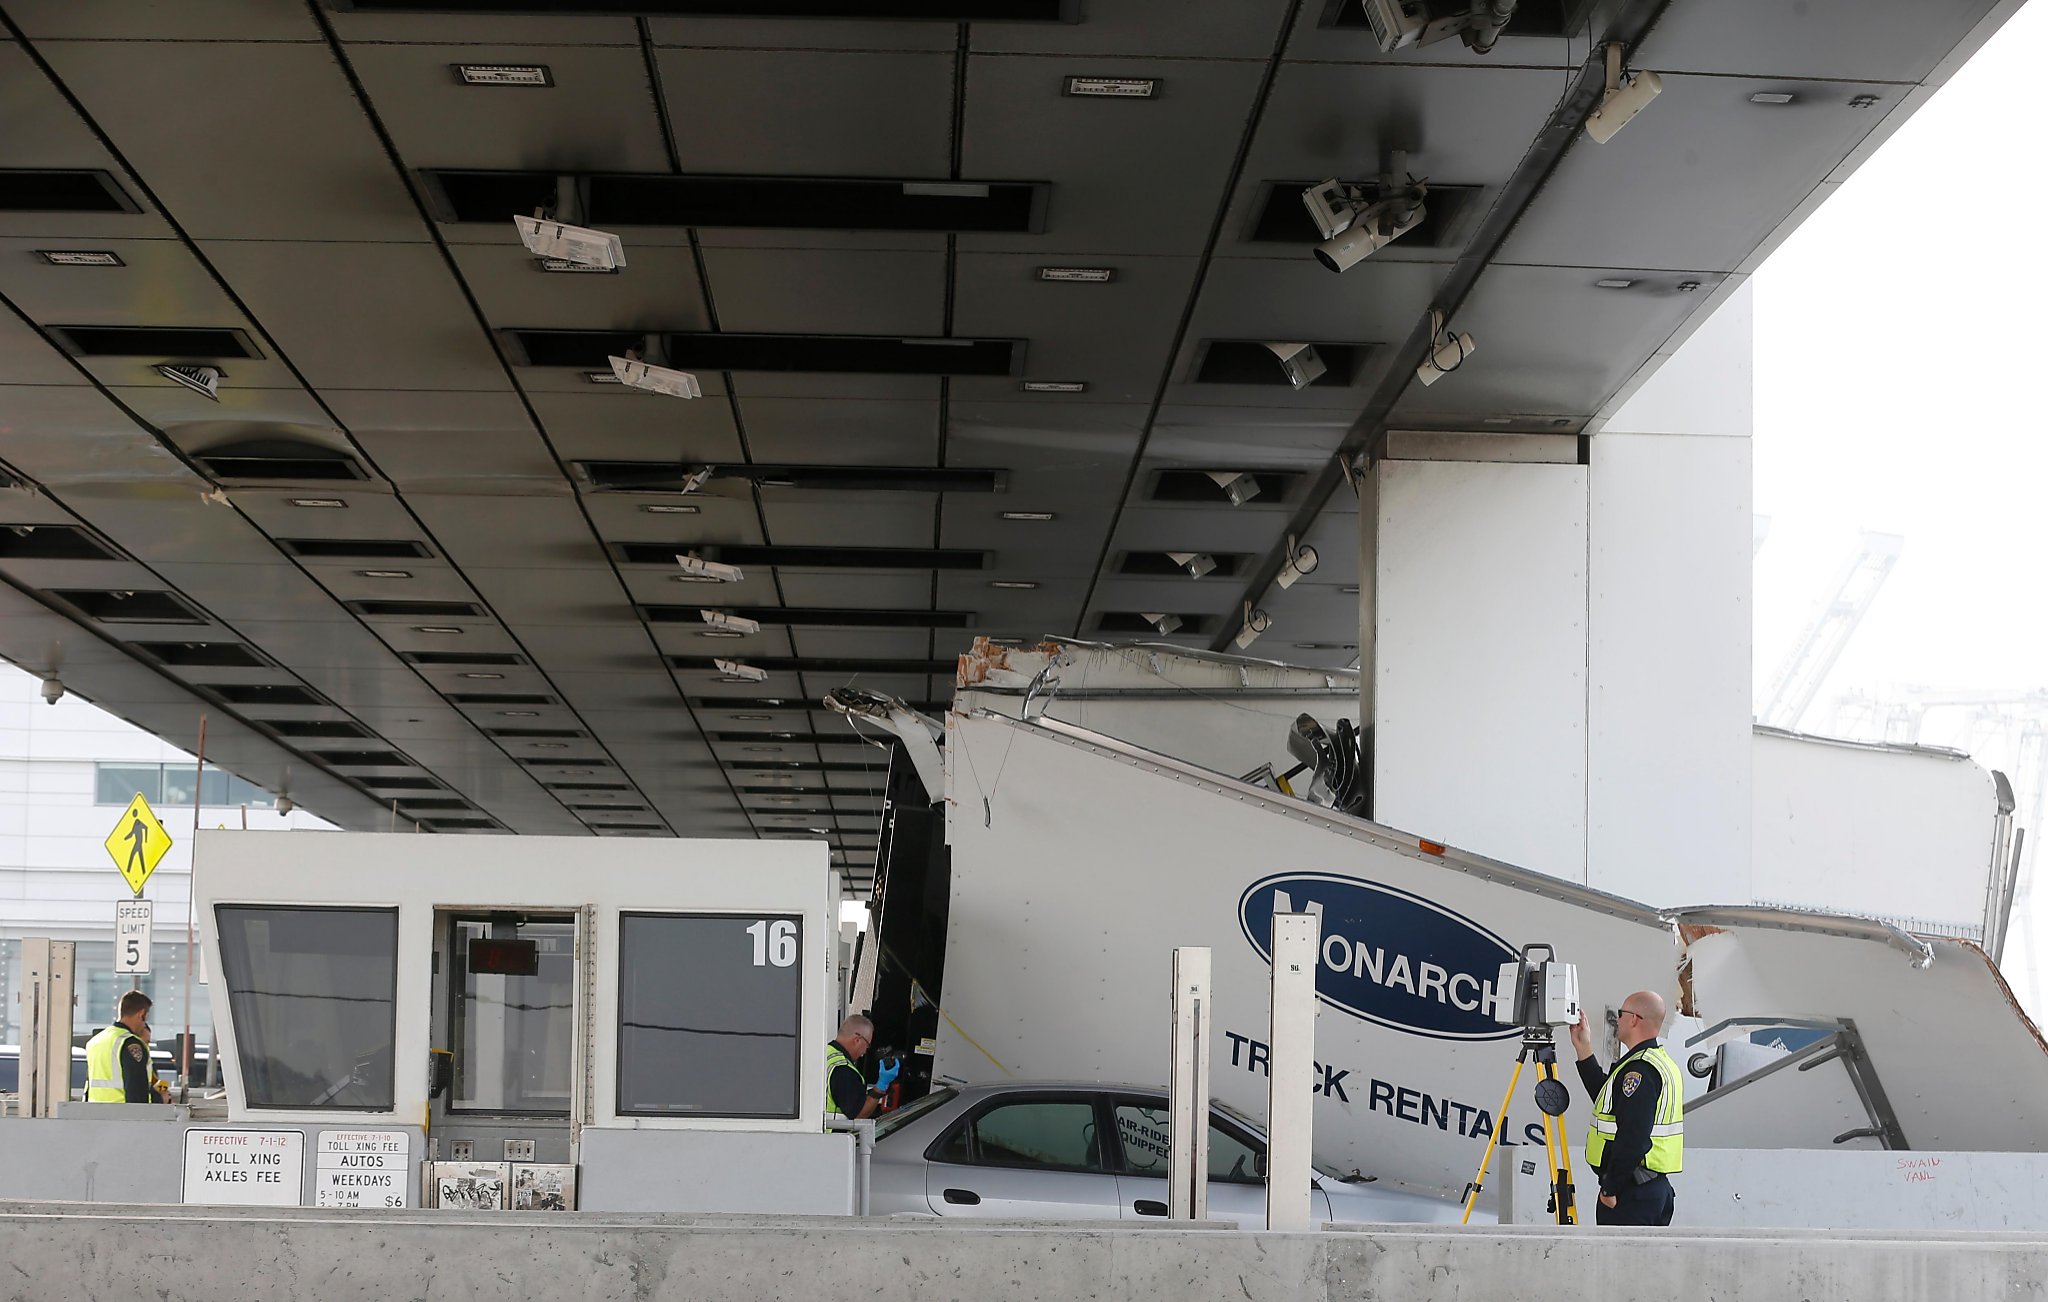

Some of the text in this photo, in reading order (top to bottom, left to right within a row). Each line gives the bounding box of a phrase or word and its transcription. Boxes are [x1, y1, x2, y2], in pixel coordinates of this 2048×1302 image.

[119, 908, 150, 919] SPEED
[121, 924, 146, 934] LIMIT
[746, 920, 797, 967] 16
[126, 940, 140, 966] 5
[1225, 1030, 1546, 1146] TRK RENTALS
[1118, 1116, 1169, 1146] AIR-RIDE
[203, 1136, 287, 1146] EFFECTIVE 7-1-12
[328, 1141, 399, 1152] TOLL XING FEE
[1120, 1131, 1169, 1160] QUIPPED
[207, 1152, 281, 1165] TOLL XING
[340, 1155, 384, 1167] AUTOS
[204, 1170, 281, 1183] AXLES FEE
[332, 1174, 392, 1187] WEEKDAYS
[320, 1190, 326, 1199] 5
[335, 1190, 344, 1199] 10
[347, 1190, 360, 1200] AM
[384, 1195, 403, 1207] $6
